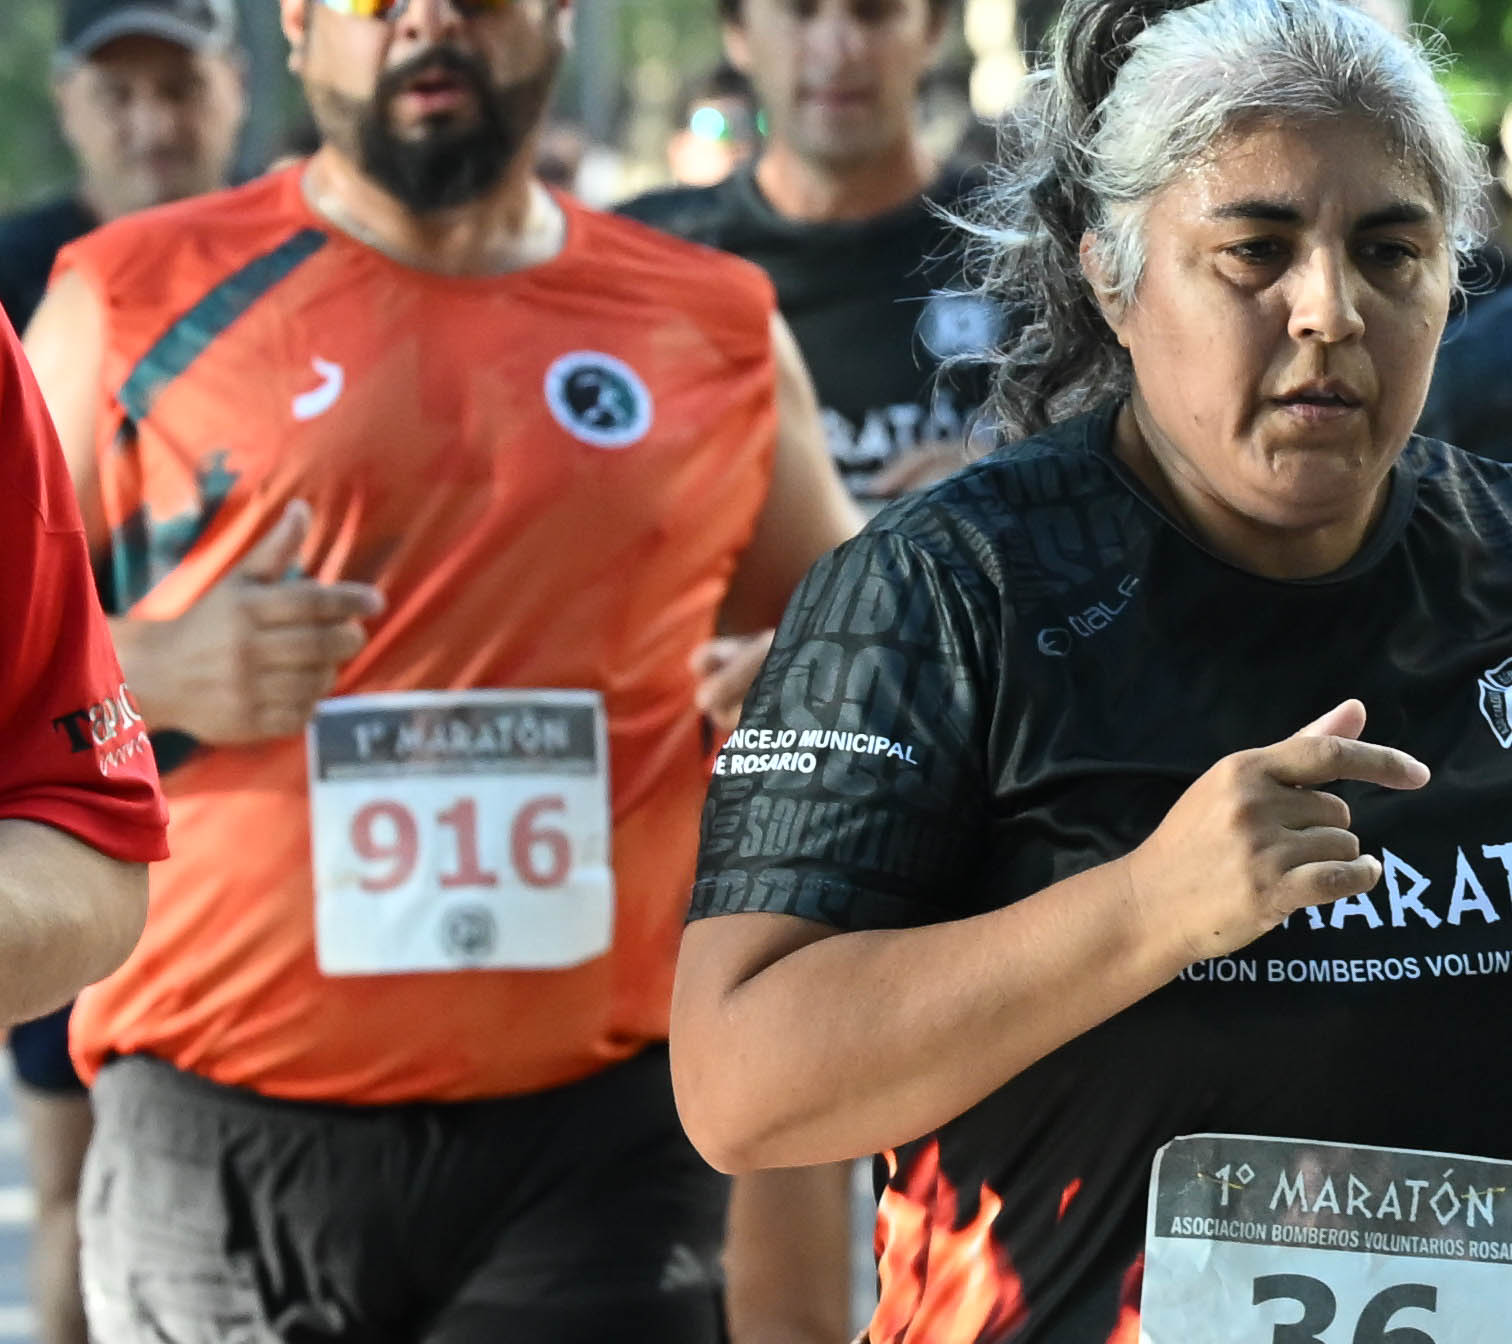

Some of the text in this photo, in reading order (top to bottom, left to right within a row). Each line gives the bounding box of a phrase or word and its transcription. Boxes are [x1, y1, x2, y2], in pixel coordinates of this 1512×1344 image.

[730, 752, 817, 775] ROSARIO
[798, 730, 918, 765] MUNICIPAL
[349, 793, 573, 894] 916
[1267, 956, 1421, 984] BOMBEROS
[1214, 1162, 1494, 1228] 1° MARATÓN
[1271, 1223, 1360, 1248] BOMBEROS
[1364, 1231, 1466, 1257] VOLUNTARIOS
